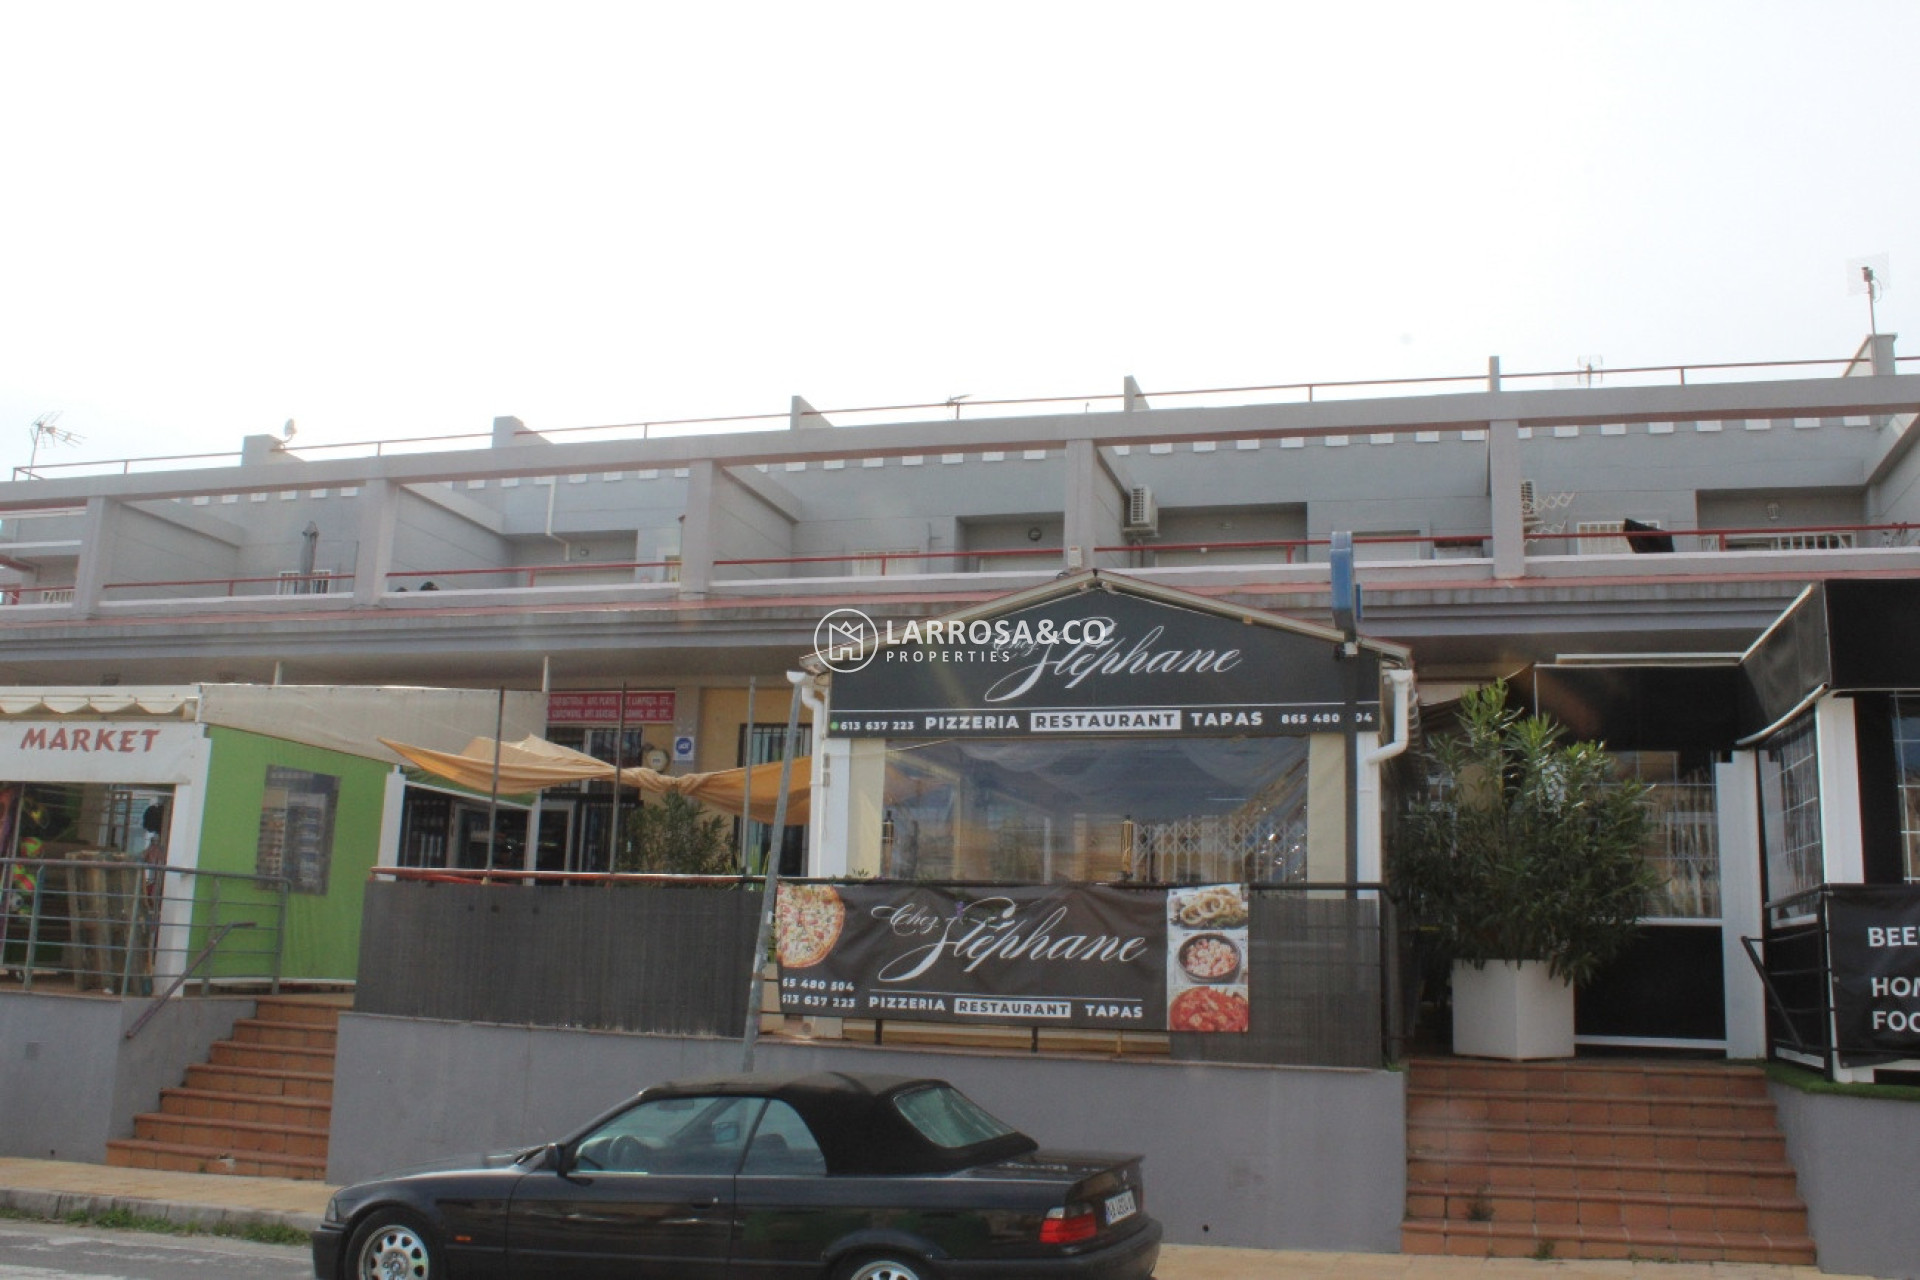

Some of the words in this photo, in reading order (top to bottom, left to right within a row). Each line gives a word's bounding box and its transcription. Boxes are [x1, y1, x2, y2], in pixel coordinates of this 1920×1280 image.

[840, 721, 861, 731] 613
[865, 721, 888, 731] 637
[893, 720, 915, 731] 223
[925, 715, 1020, 731] PIZZERIA
[1034, 713, 1175, 729] RESTAURANT
[1190, 711, 1264, 727] TAPAS
[1281, 713, 1308, 725] 865
[1312, 712, 1341, 724] 480
[1355, 711, 1373, 723] 04
[20, 727, 161, 753] MARKET
[871, 903, 940, 936] Chez
[1867, 926, 1920, 948] BEE
[868, 996, 946, 1011] PIZZERIA
[958, 1000, 1069, 1016] RESTAURANT
[1085, 1004, 1143, 1019] TAPAS
